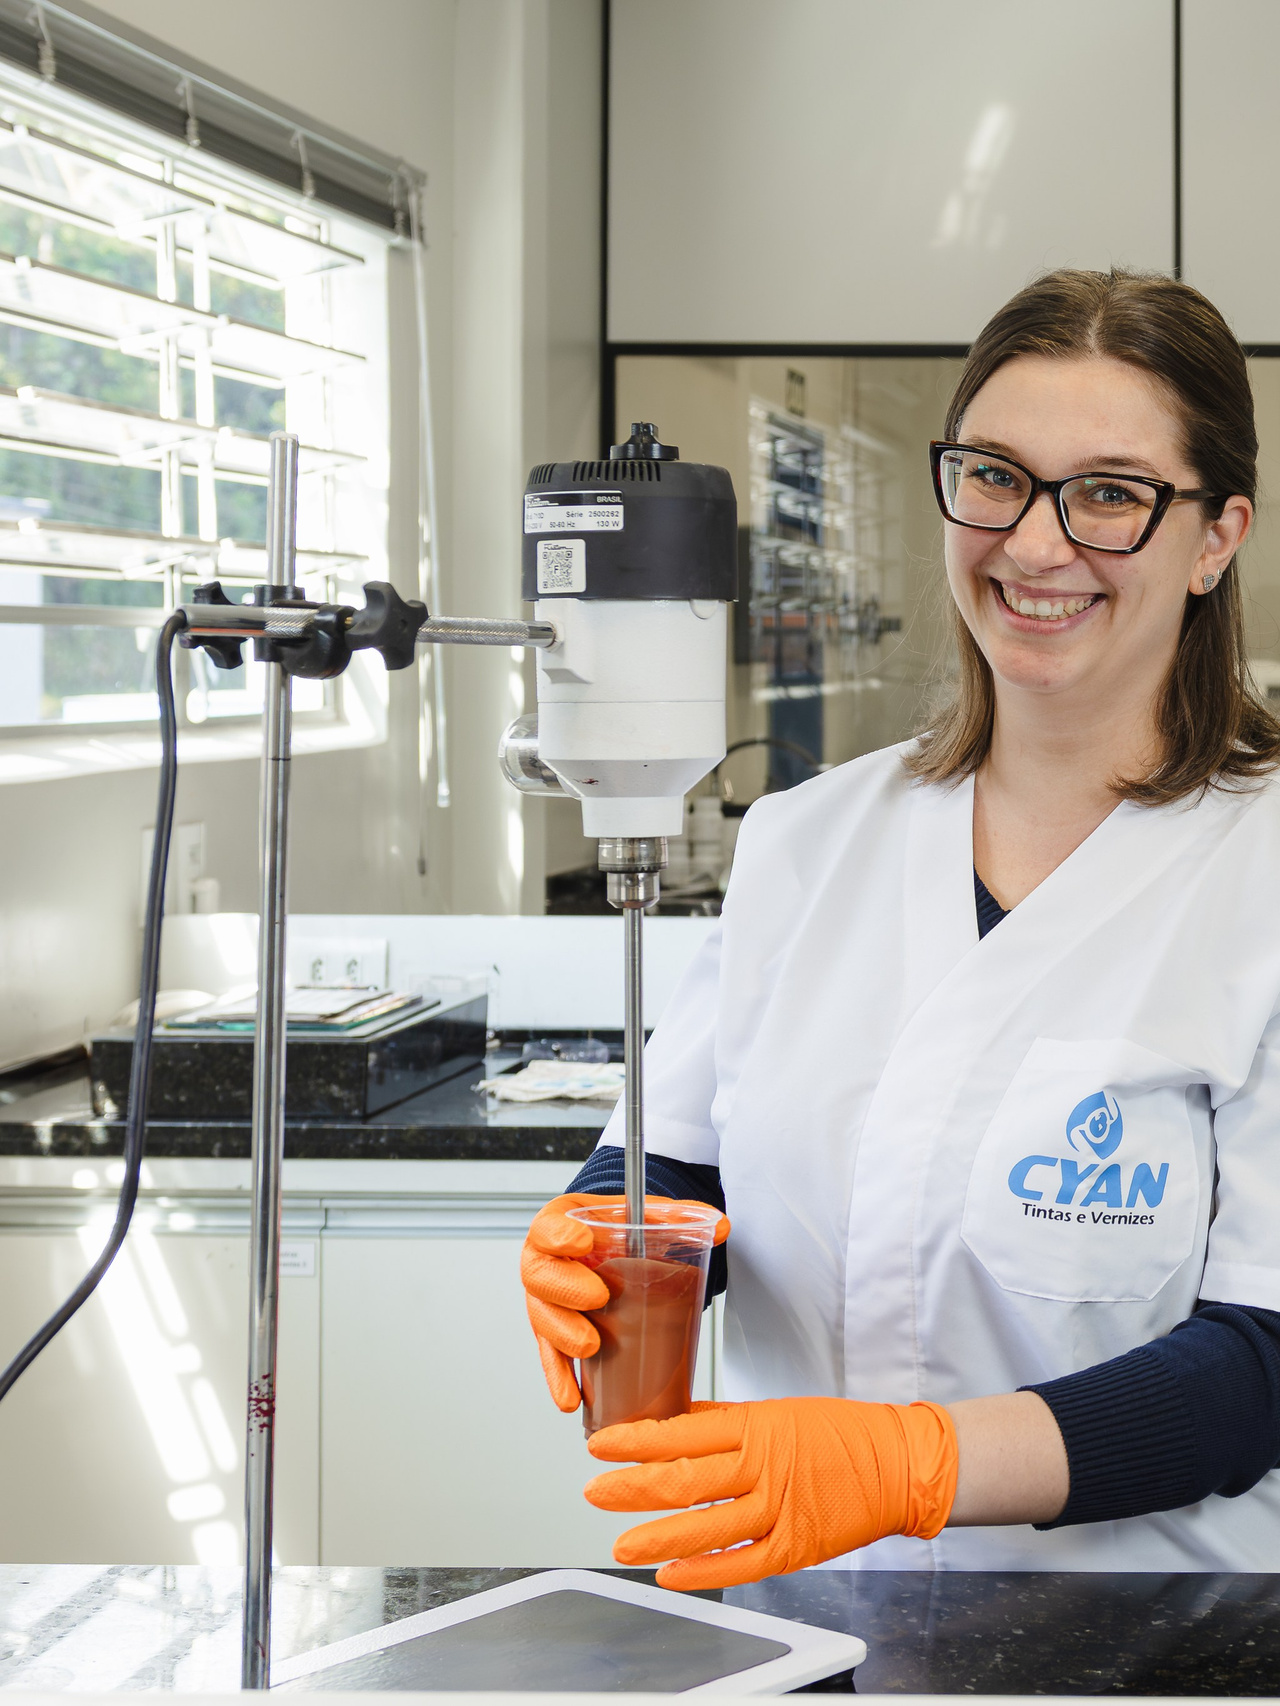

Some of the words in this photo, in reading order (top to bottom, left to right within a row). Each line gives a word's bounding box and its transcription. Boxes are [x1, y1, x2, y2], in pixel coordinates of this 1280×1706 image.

[1008, 1154, 1170, 1209] CYAN
[1021, 1202, 1072, 1222] Tintas
[1076, 1213, 1086, 1223] e
[1091, 1211, 1155, 1225] Vernizes
